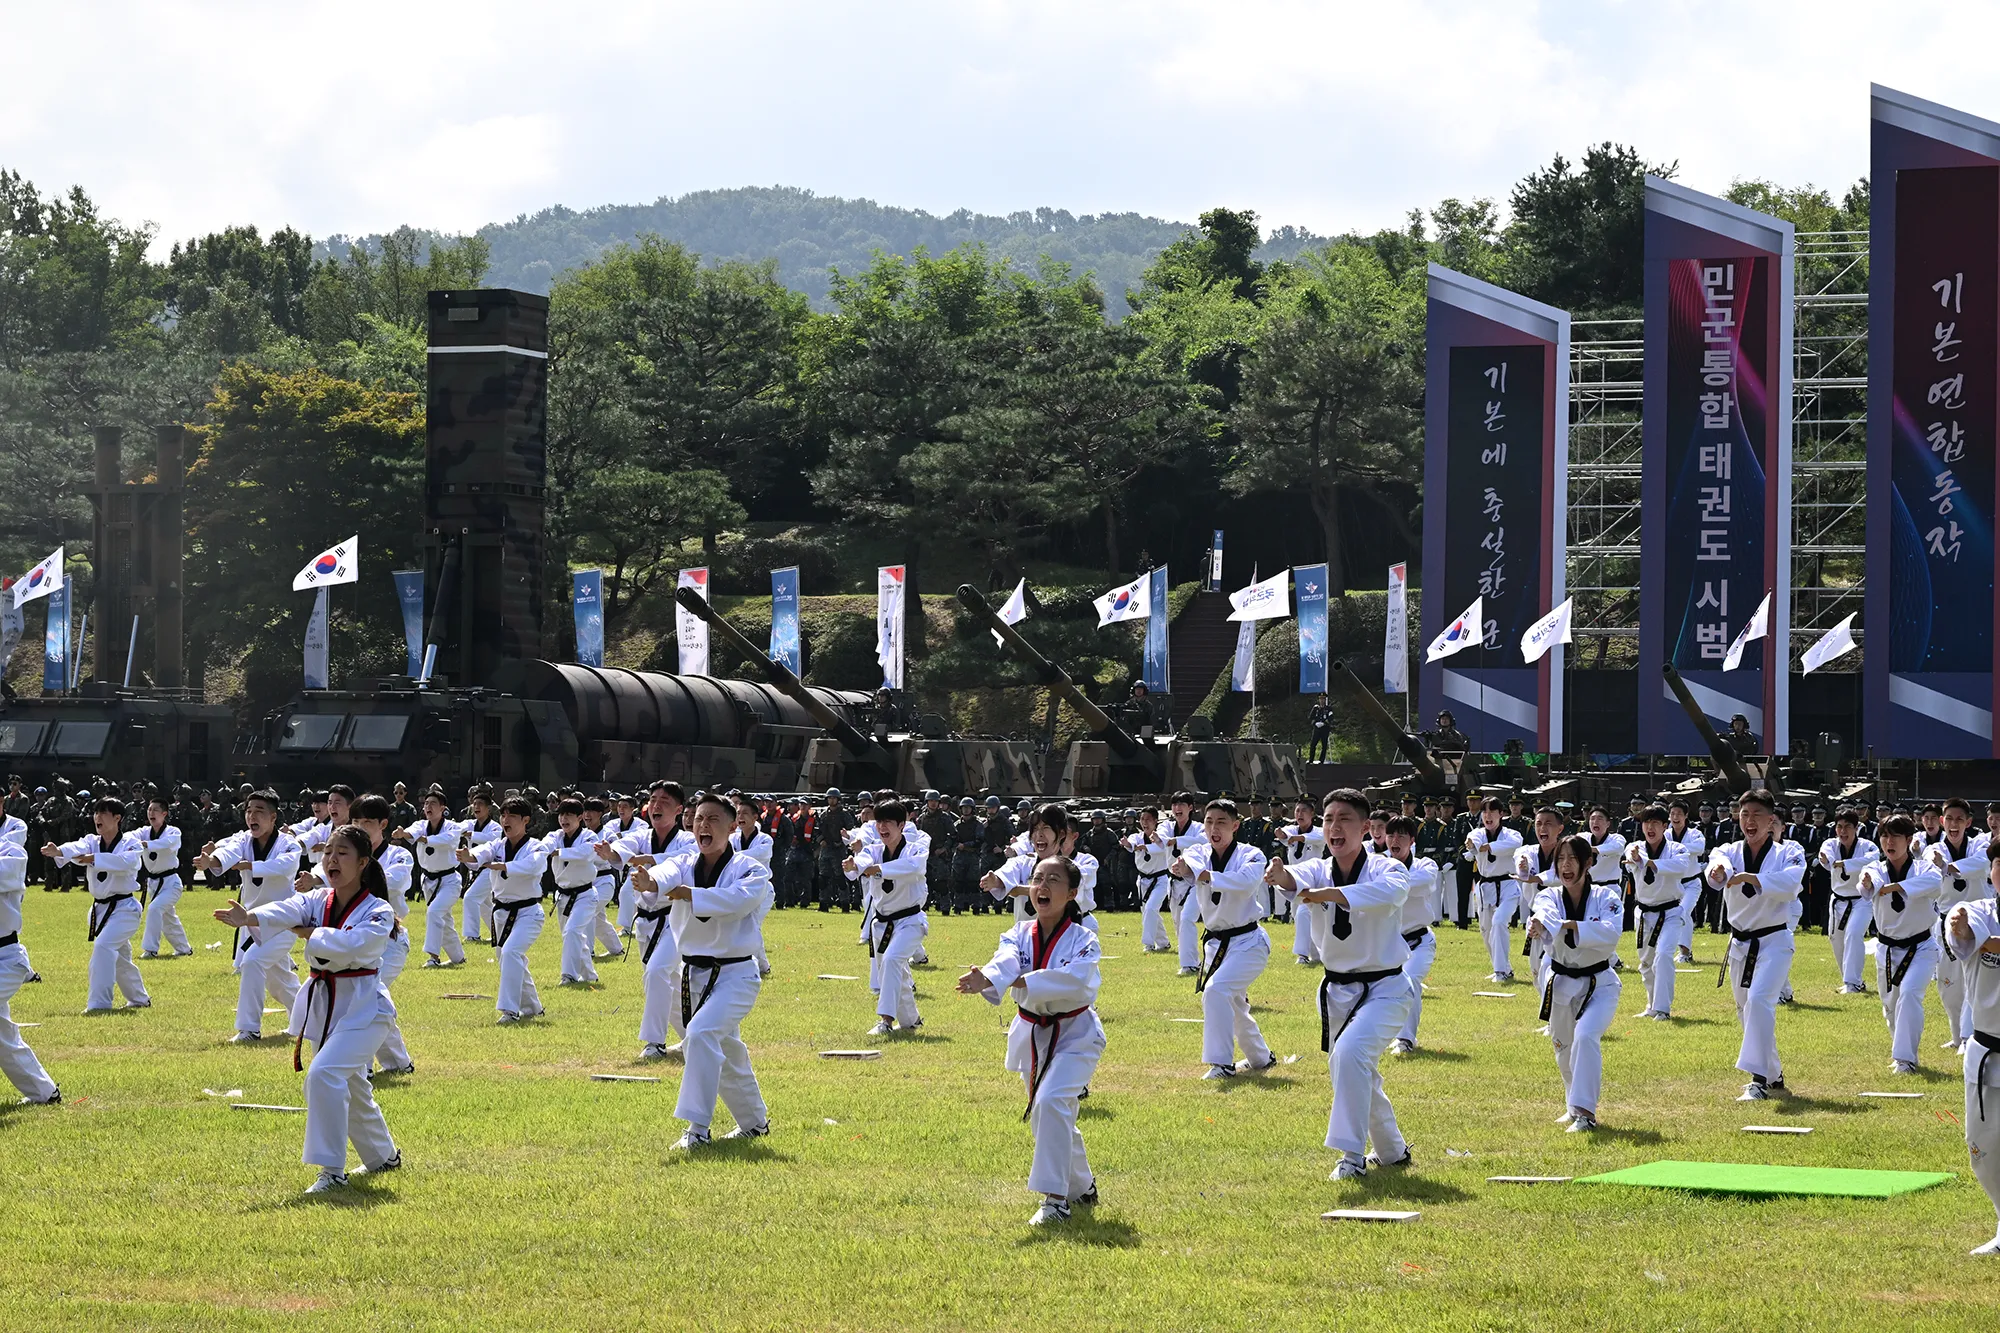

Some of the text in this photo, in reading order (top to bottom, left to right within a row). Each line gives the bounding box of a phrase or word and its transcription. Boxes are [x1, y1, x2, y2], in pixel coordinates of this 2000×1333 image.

[1478, 362, 1507, 650] 기본에 충실한 군
[1696, 264, 1735, 659] 민군통합 태권도 시범
